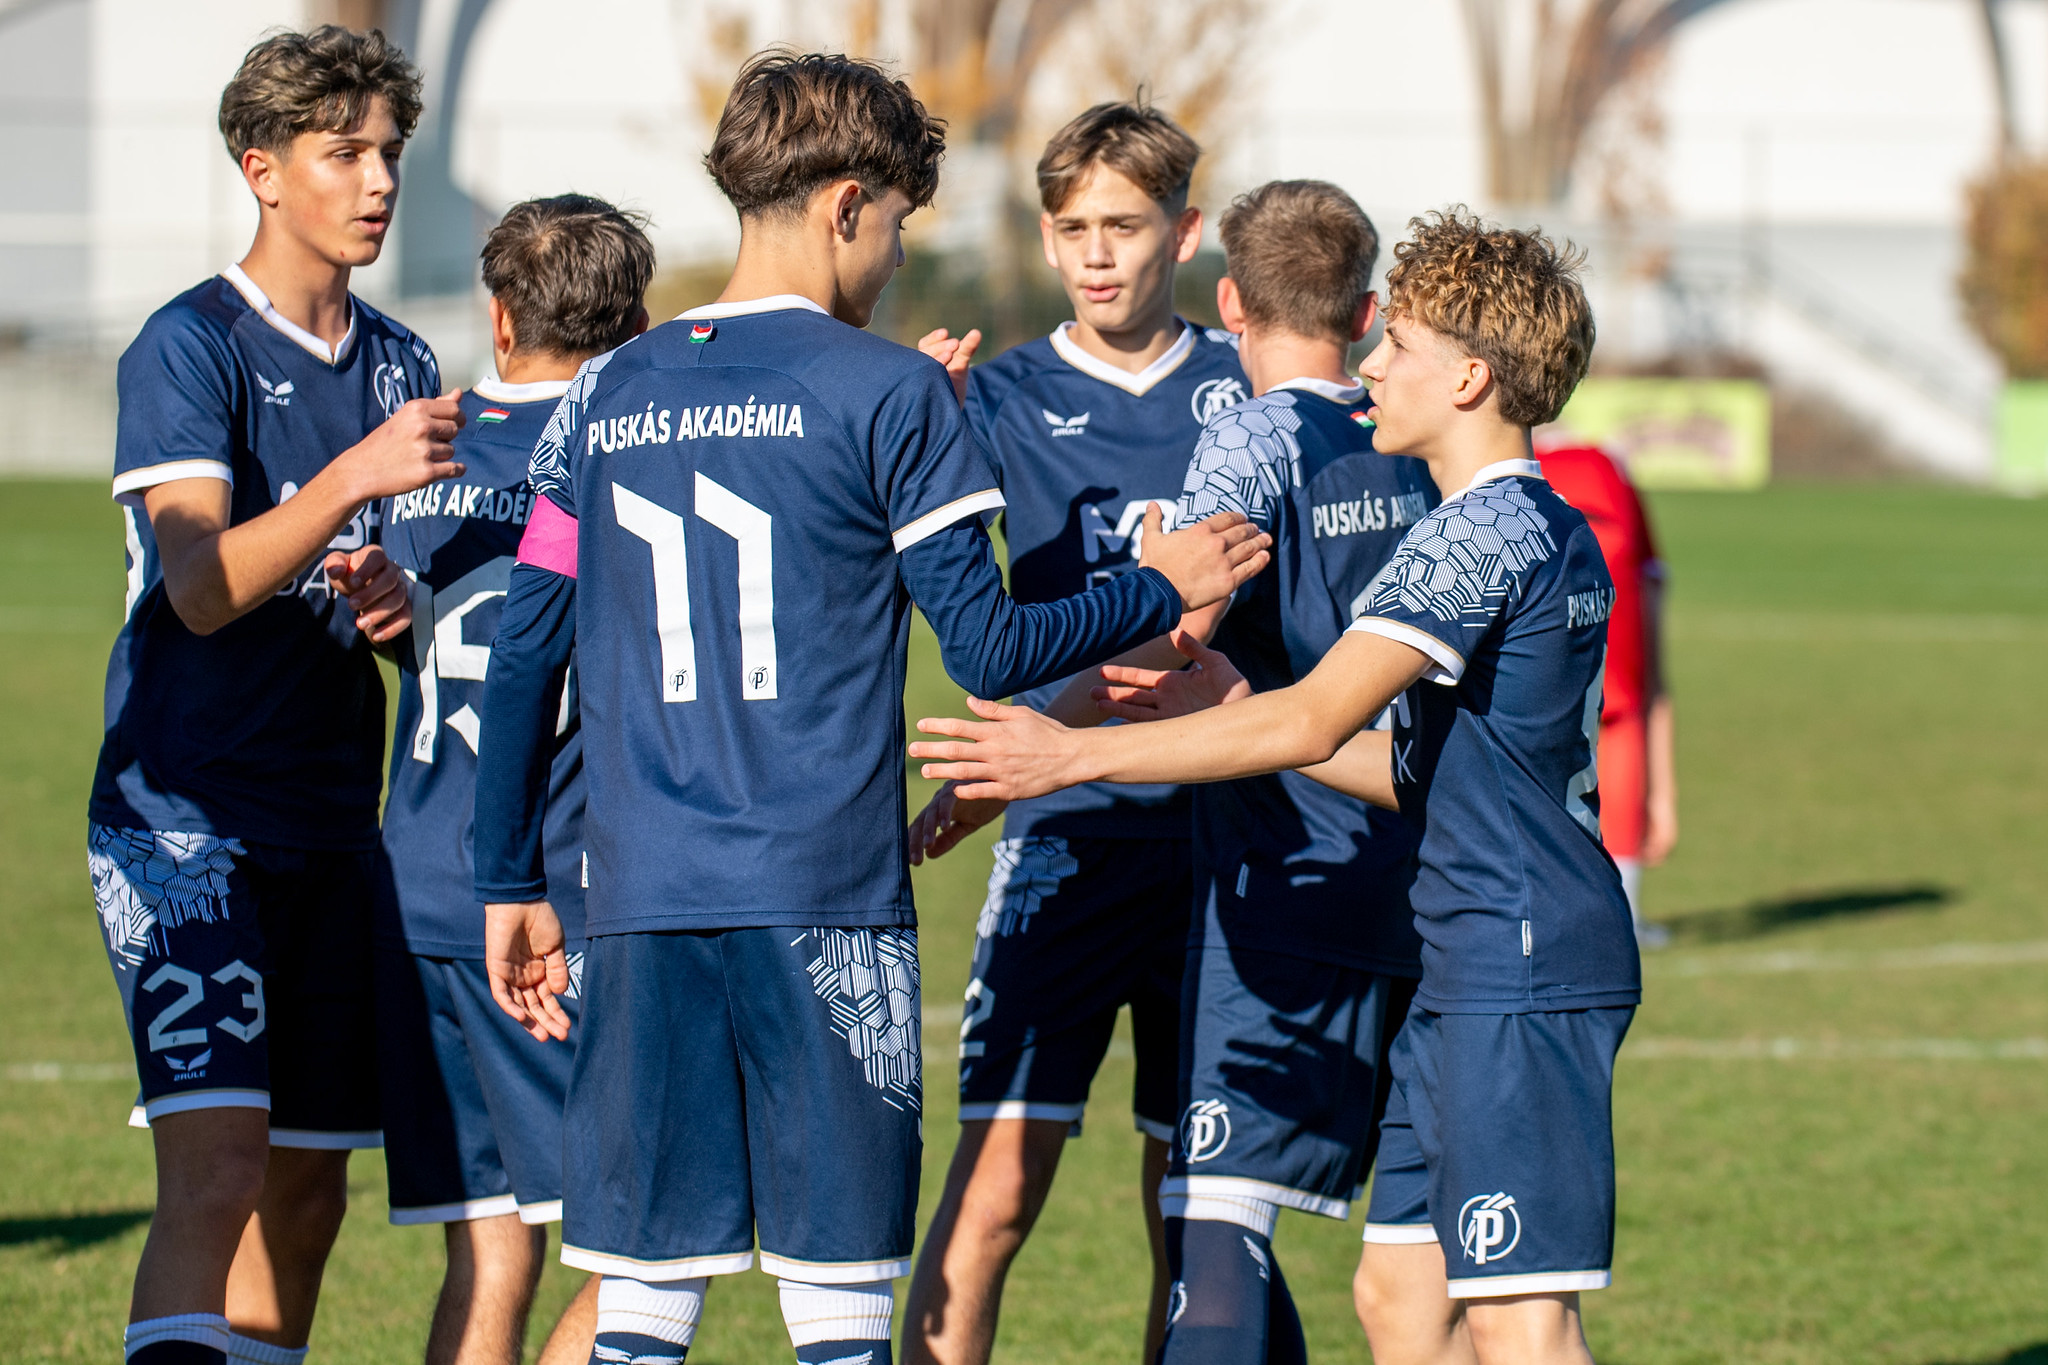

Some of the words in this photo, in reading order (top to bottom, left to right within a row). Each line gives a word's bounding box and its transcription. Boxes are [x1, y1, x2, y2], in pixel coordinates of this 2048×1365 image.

[587, 401, 671, 456] PUSKÁS
[676, 394, 804, 442] AKADÉMIA
[1312, 489, 1386, 538] PUSKÁS
[612, 471, 778, 703] 11
[1567, 580, 1606, 628] PUSKÁS
[142, 959, 266, 1053] 23
